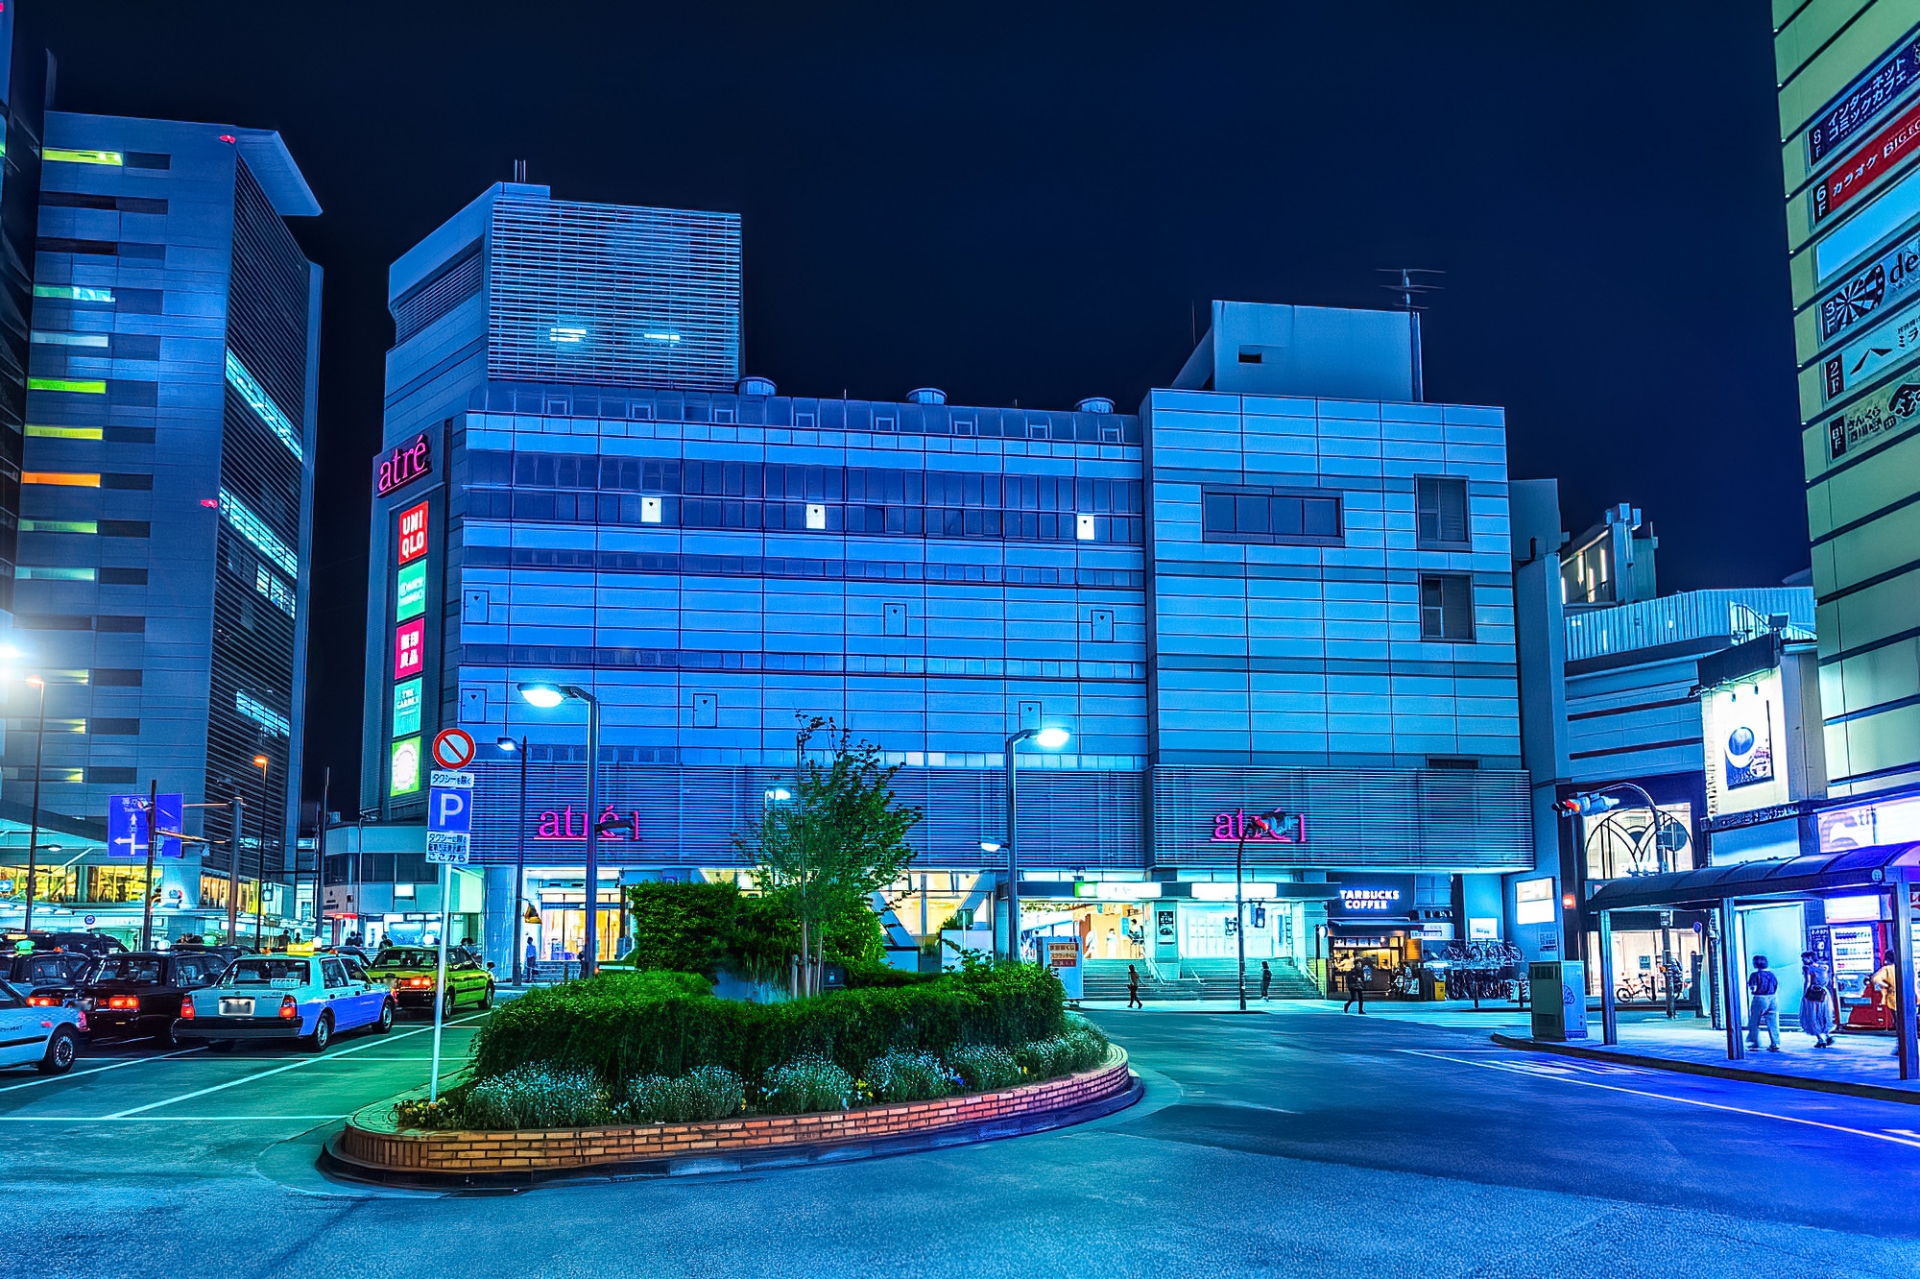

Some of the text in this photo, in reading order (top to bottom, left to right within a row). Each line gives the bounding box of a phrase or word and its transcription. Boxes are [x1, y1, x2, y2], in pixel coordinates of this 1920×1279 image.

[1828, 58, 1905, 126] インターネット
[1829, 70, 1907, 141] コミックカフェ
[1833, 154, 1878, 196] カラオケ
[1883, 131, 1907, 159] BIG
[1816, 185, 1826, 217] 6F
[378, 434, 427, 492] atré
[402, 510, 423, 535] UNI
[402, 531, 424, 558] QLO
[440, 793, 464, 826] P
[1340, 889, 1400, 901] TARBUCKS
[1345, 900, 1388, 910] COFFEE
